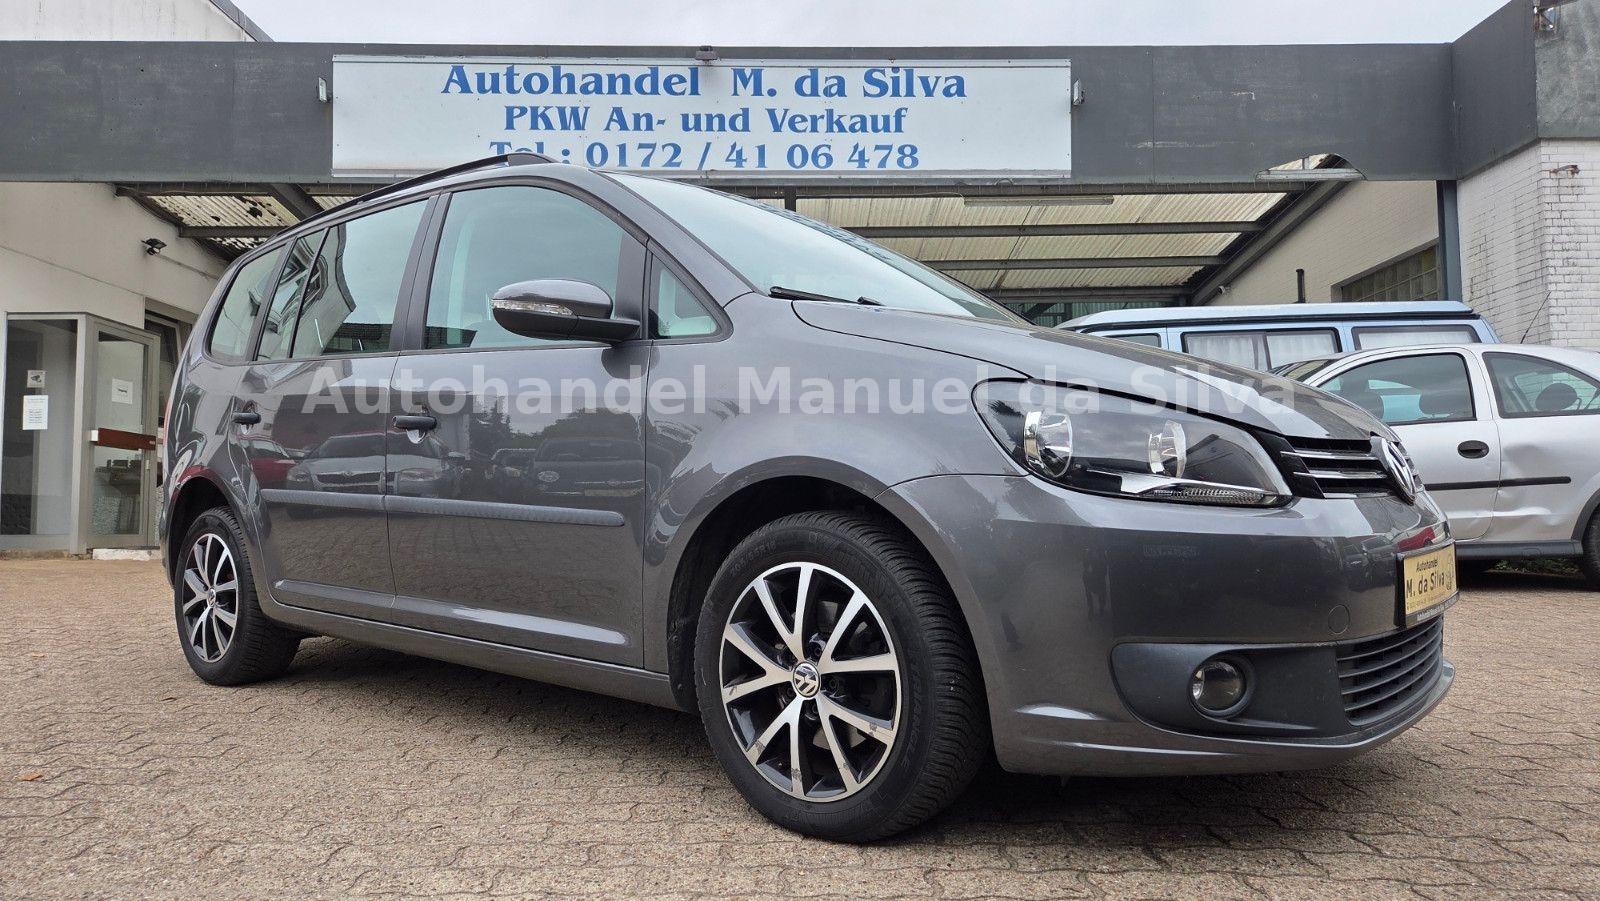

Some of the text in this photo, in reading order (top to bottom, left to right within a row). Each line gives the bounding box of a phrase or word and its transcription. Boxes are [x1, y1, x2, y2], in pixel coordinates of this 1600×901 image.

[441, 64, 967, 99] Autohandel M. da Silva
[504, 104, 908, 134] PKW An- und Verkauf
[585, 140, 683, 168] 0172
[725, 142, 768, 169] 41
[786, 143, 835, 170] 06
[847, 142, 921, 170] 478
[1406, 570, 1445, 598] M. da Silva
